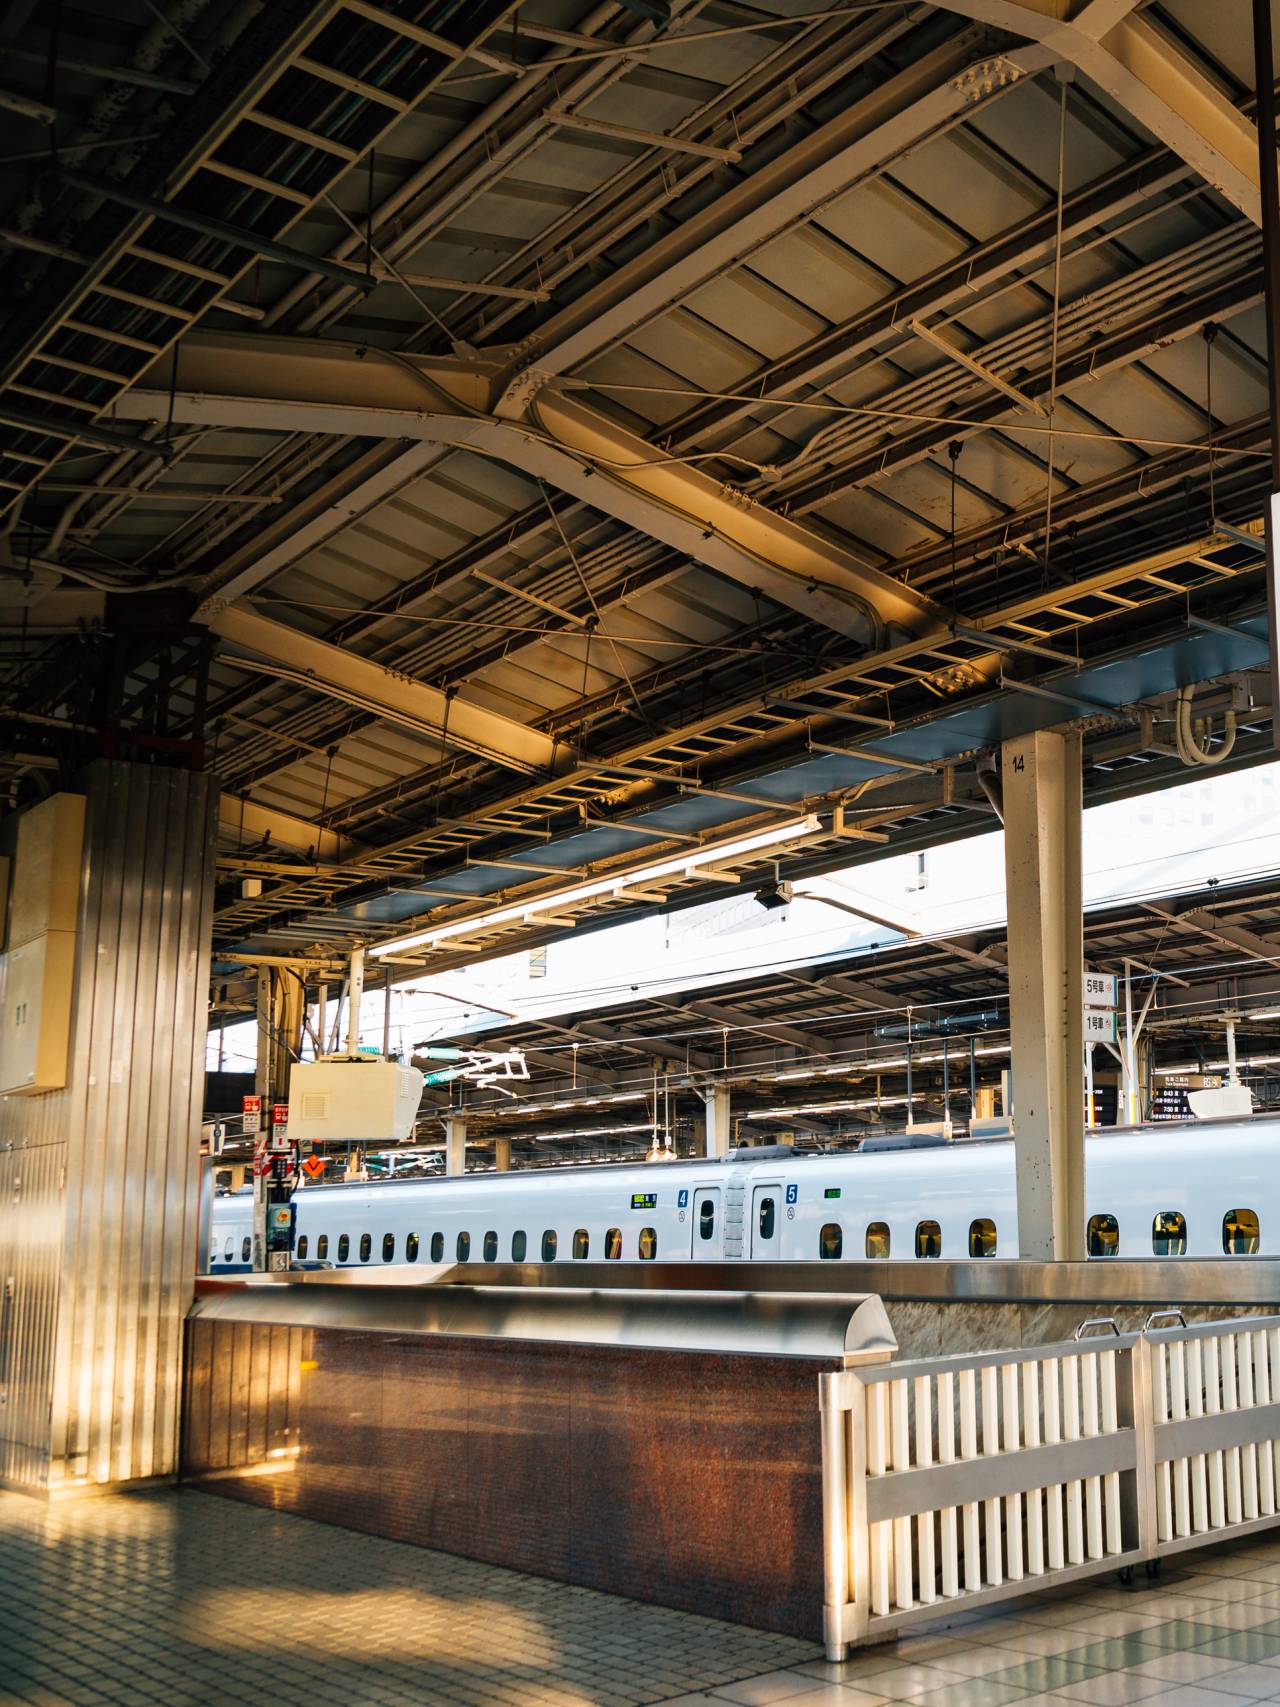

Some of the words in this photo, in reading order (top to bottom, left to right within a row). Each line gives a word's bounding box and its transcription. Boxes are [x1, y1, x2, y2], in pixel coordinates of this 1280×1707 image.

[1012, 754, 1025, 774] 14
[1086, 979, 1105, 993] 5号車
[1087, 1016, 1104, 1030] 1号車
[679, 1191, 686, 1206] 4
[788, 1187, 796, 1202] 5
